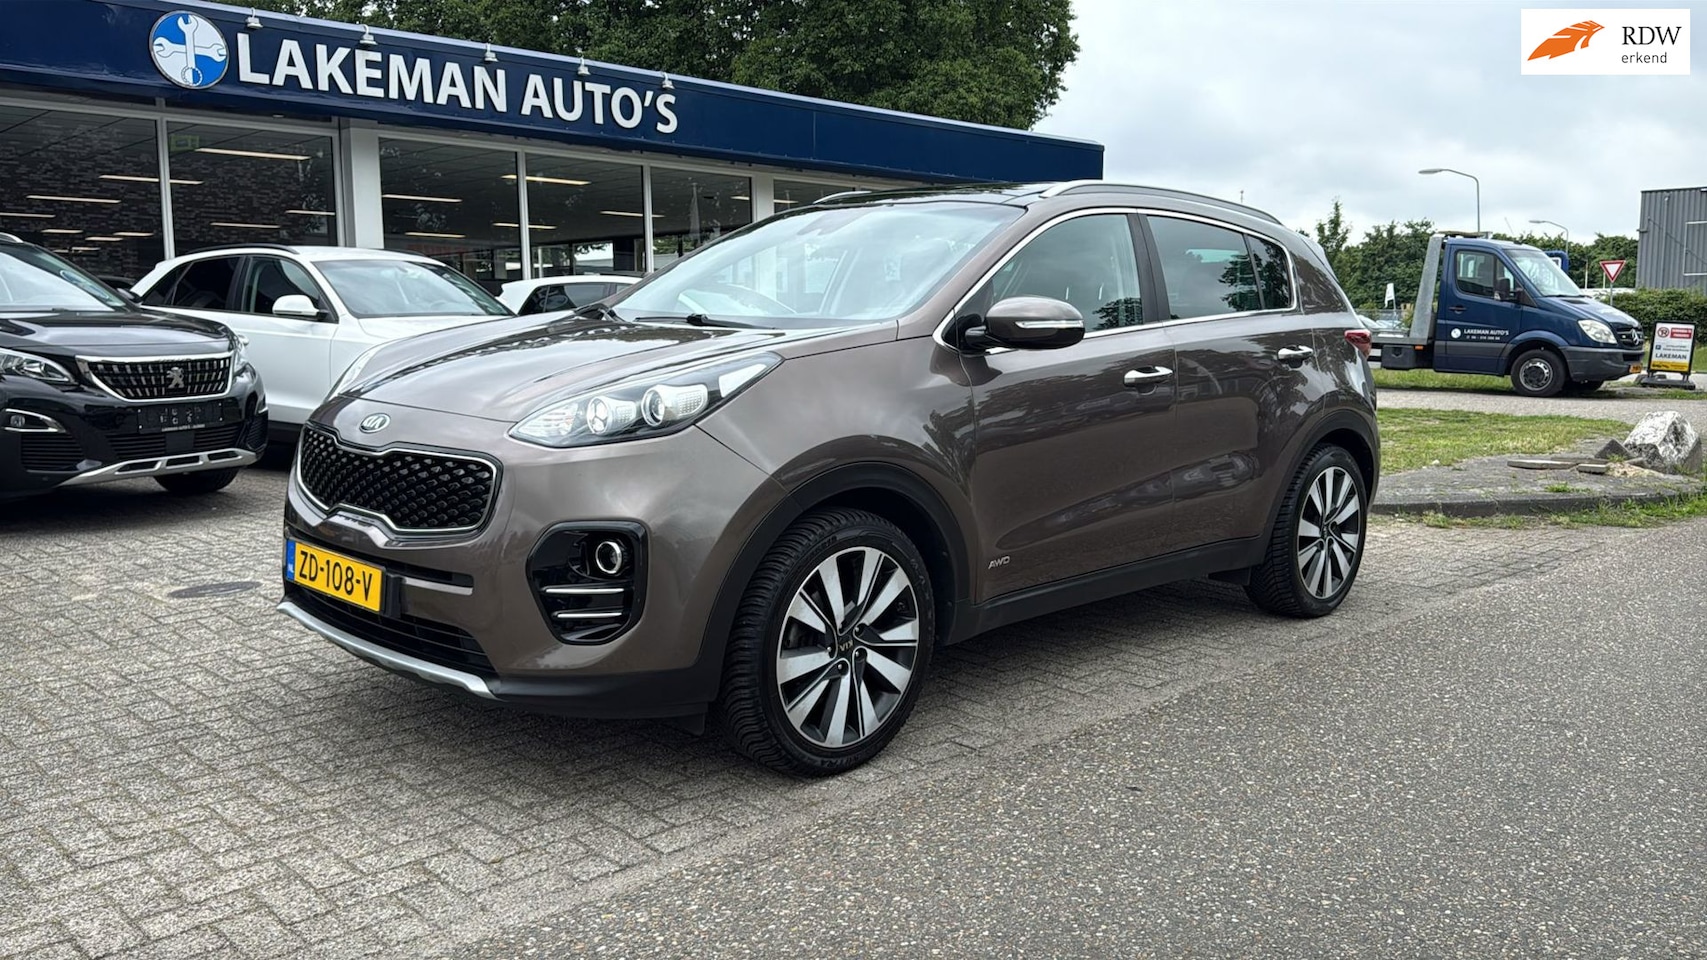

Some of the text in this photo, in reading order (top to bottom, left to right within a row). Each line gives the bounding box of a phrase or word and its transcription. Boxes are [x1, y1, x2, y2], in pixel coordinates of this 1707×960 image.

[237, 32, 678, 134] LAKEMAN AUTO'S
[299, 550, 373, 601] ZD-108-V
[987, 555, 1010, 570] AWD
